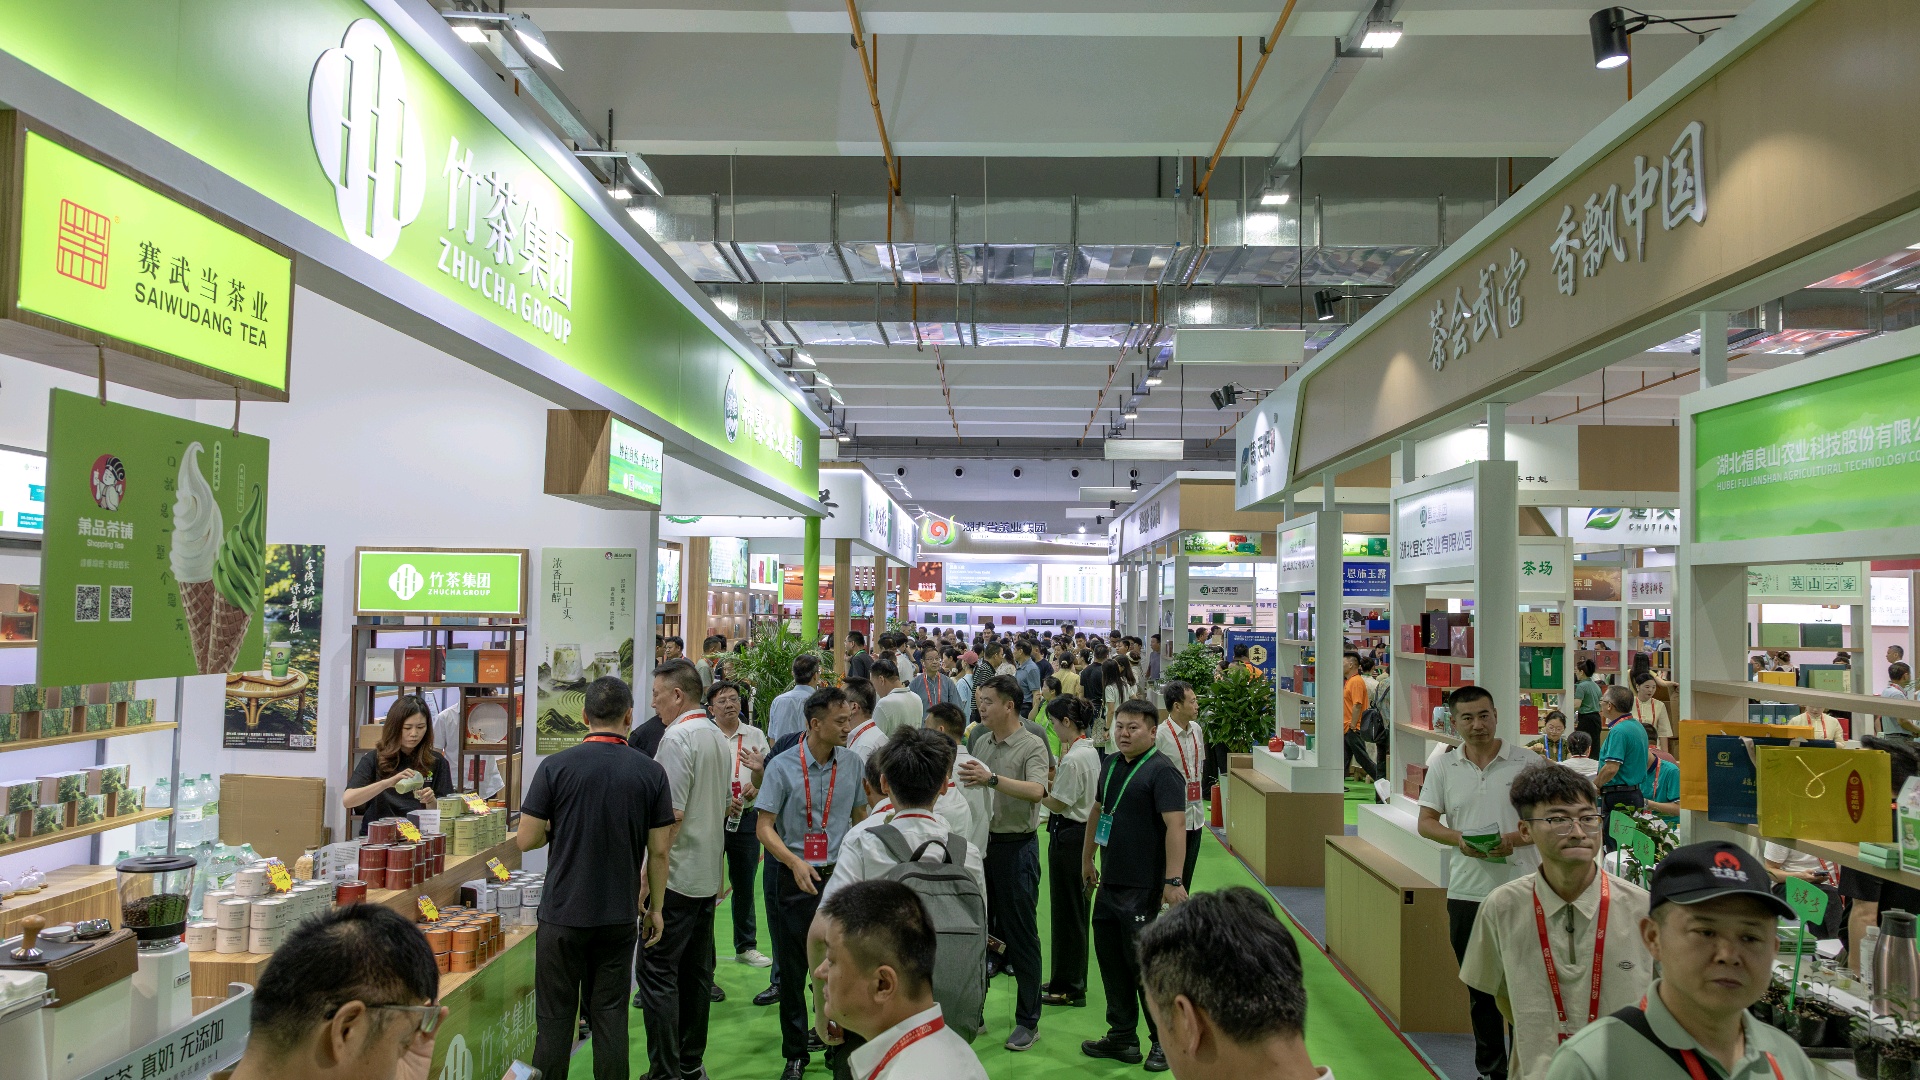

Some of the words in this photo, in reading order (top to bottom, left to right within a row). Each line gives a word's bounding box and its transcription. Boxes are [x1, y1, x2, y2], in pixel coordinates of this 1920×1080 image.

[440, 135, 574, 313] 竹茶集团
[138, 239, 270, 324] 赛武当茶业
[438, 236, 518, 315] ZHUCHA
[520, 291, 573, 345] GROUP
[135, 281, 233, 337] SAIWUDANG
[240, 321, 269, 349] TEA
[1716, 479, 1738, 492] HUBEI
[1738, 474, 1783, 489] FULIANSHAN
[1784, 464, 1843, 482] AGRICULTURAL
[1845, 452, 1907, 472] TECHNOLOGY
[86, 539, 112, 550] Shopping
[113, 540, 124, 549] Tea
[1399, 529, 1473, 560] 湖北宜红茶业有限公司
[429, 571, 491, 588] 竹茶集团
[551, 557, 563, 604] 浓香甘醇
[1346, 568, 1387, 580] 恩施玉露
[1521, 560, 1553, 576] 茶场
[1790, 576, 1856, 591] 英山云雾
[428, 588, 461, 596] ZHUCHA
[180, 1018, 225, 1063] 无添加
[479, 988, 537, 1073] 竹茶集团
